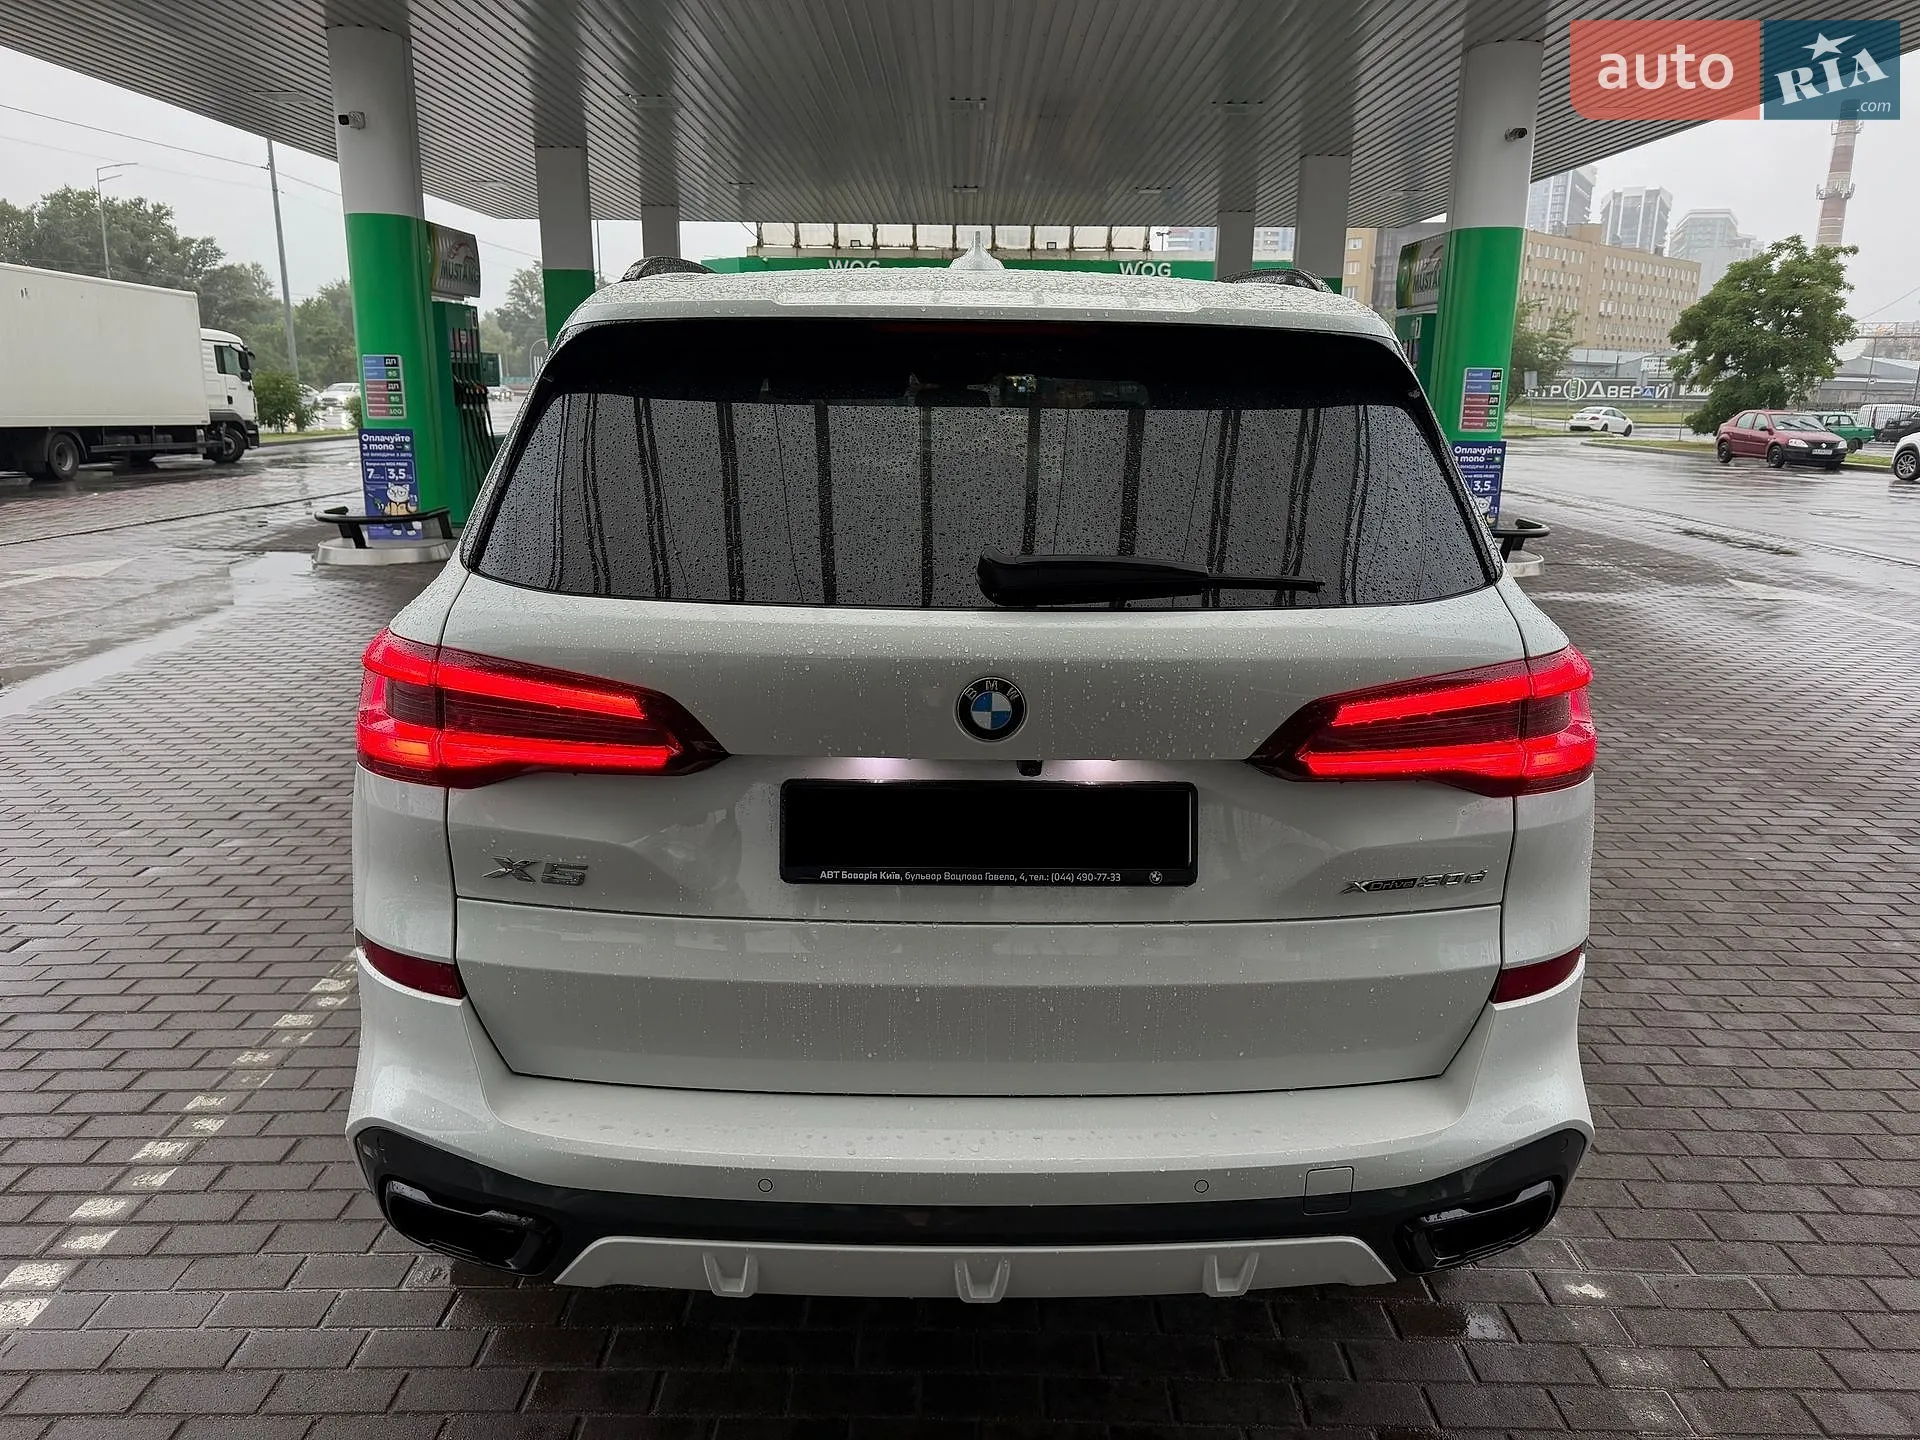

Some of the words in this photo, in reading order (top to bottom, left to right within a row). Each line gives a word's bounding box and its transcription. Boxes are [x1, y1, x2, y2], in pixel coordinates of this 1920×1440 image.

[440, 259, 480, 281] MUSTANG
[1119, 261, 1171, 277] WOG
[1413, 270, 1441, 293] MUSTA
[361, 433, 411, 443] Оплачуйте
[1454, 446, 1502, 455] Оплачуйте
[366, 468, 375, 479] 7
[387, 468, 406, 480] 3,5
[1473, 480, 1492, 492] 3,5
[964, 680, 1020, 700] BMW
[482, 856, 588, 887] X5
[820, 870, 840, 879] АВТ
[841, 870, 878, 881] Баварія
[904, 871, 942, 882] бульвар
[1019, 872, 1028, 882] 4,
[1051, 872, 1074, 883] (044)
[1076, 872, 1121, 881] 490-77-33
